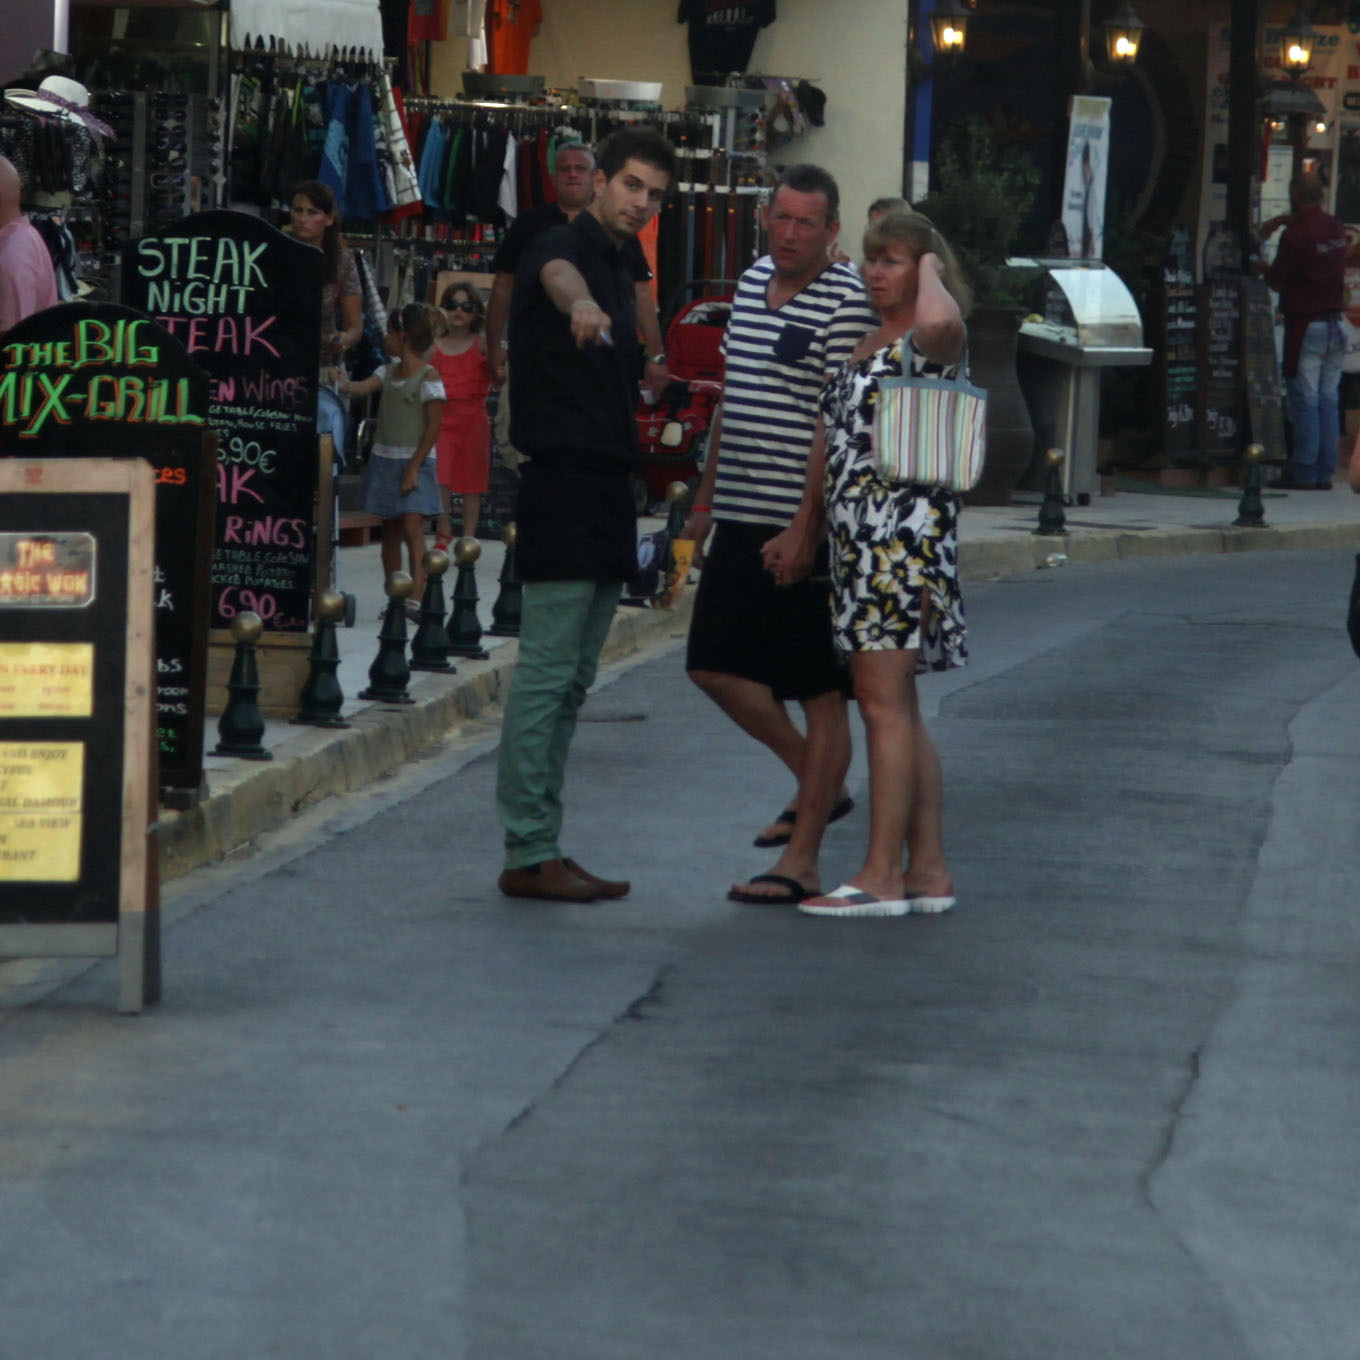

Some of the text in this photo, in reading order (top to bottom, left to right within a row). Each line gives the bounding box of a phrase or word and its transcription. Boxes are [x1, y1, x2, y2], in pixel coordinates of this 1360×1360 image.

[138, 237, 269, 289] STEAK
[2, 319, 159, 370] THE BIG
[156, 315, 282, 359] TEAK
